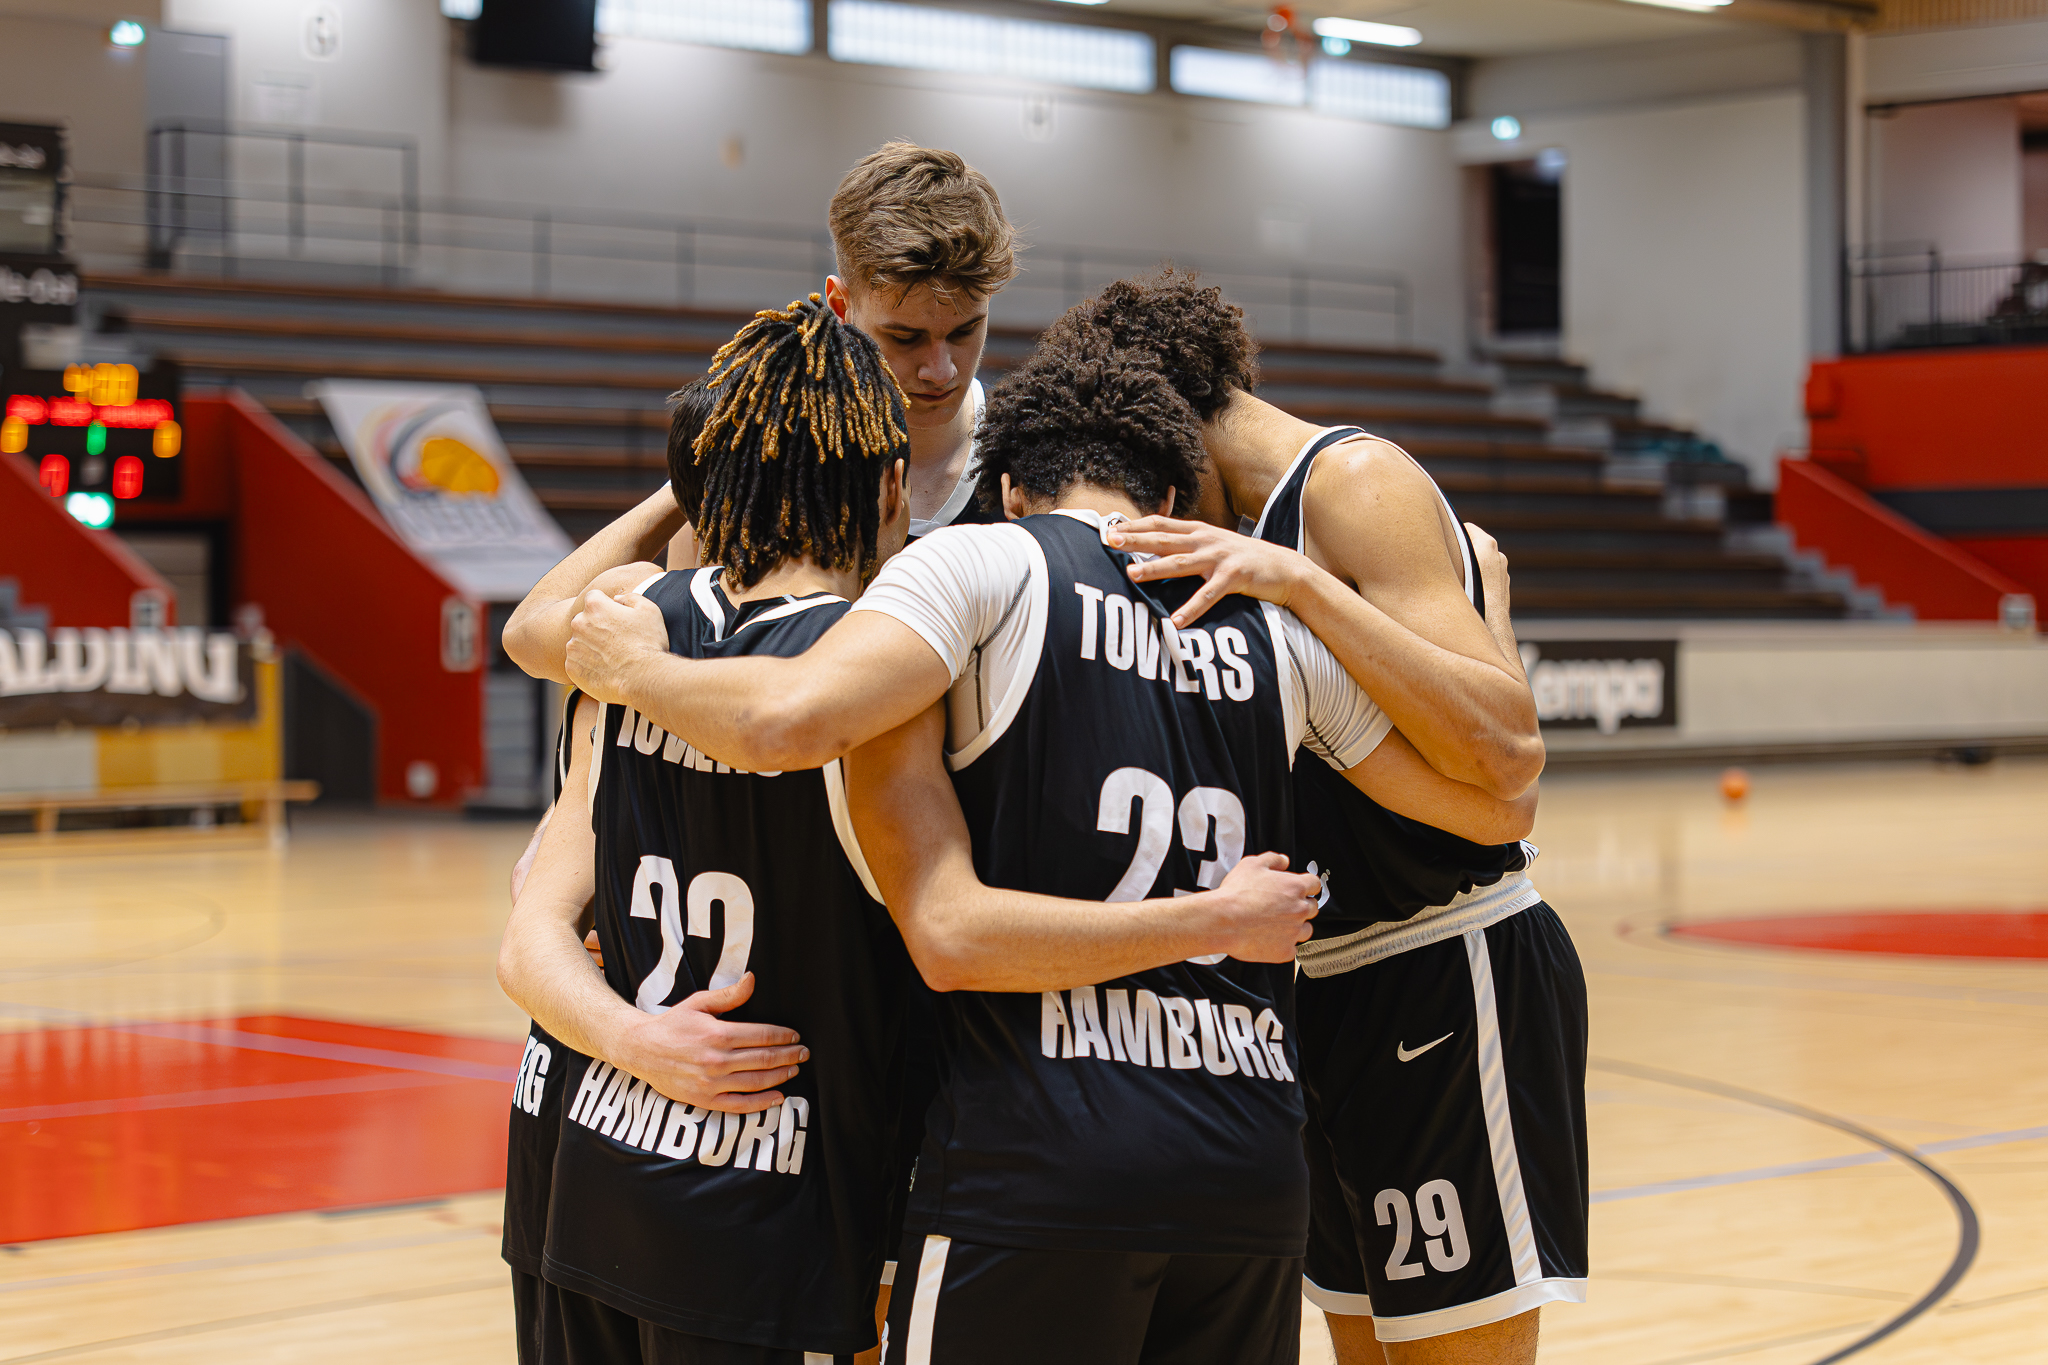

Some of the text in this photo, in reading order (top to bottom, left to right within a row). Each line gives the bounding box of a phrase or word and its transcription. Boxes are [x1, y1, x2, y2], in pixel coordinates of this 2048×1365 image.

[1074, 581, 1255, 702] TOWERS
[629, 855, 755, 1016] 22
[1041, 985, 1296, 1083] HAMBURG
[567, 1058, 810, 1175] HAMBURG
[1373, 1178, 1471, 1281] 29
